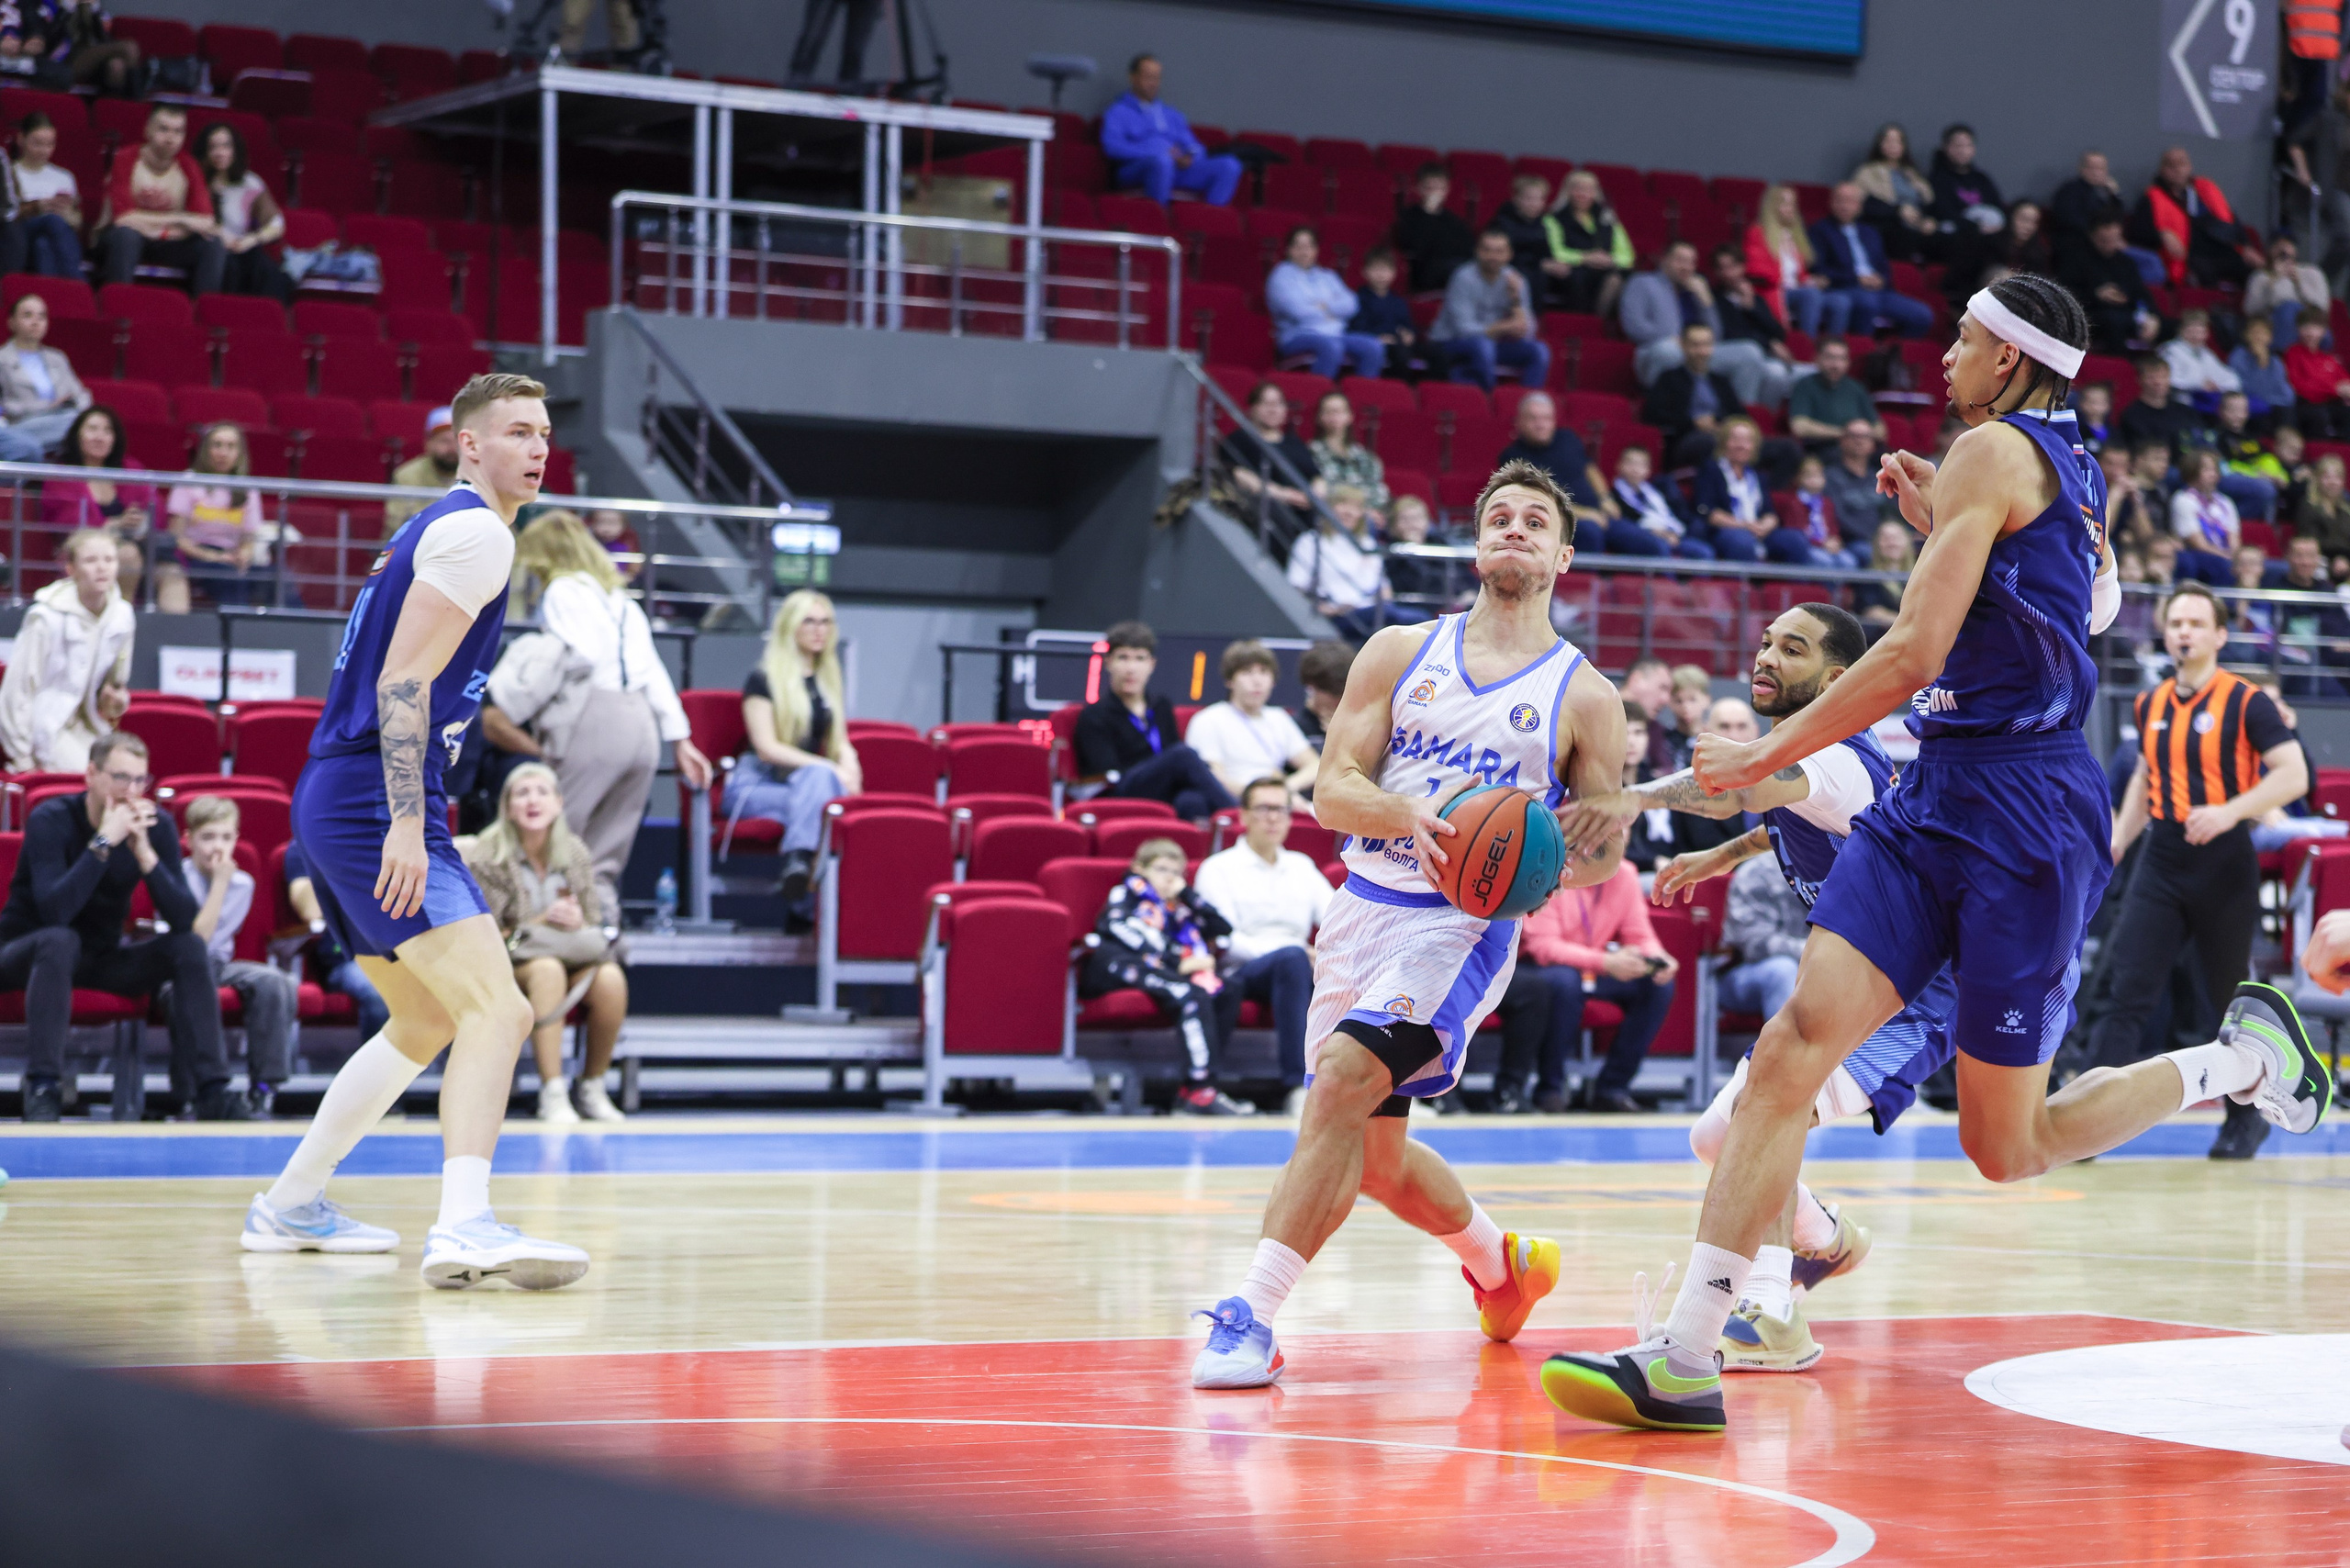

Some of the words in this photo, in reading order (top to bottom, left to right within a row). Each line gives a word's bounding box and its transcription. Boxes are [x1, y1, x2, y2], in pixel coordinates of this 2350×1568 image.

[2224, 0, 2256, 65] 9
[1391, 726, 1521, 788] SAMARA
[1383, 847, 1419, 873] ВОЛГА
[1472, 829, 1515, 908] JÖGEL
[1995, 1025, 2028, 1035] KELME
[1707, 1280, 1733, 1295] adidas
